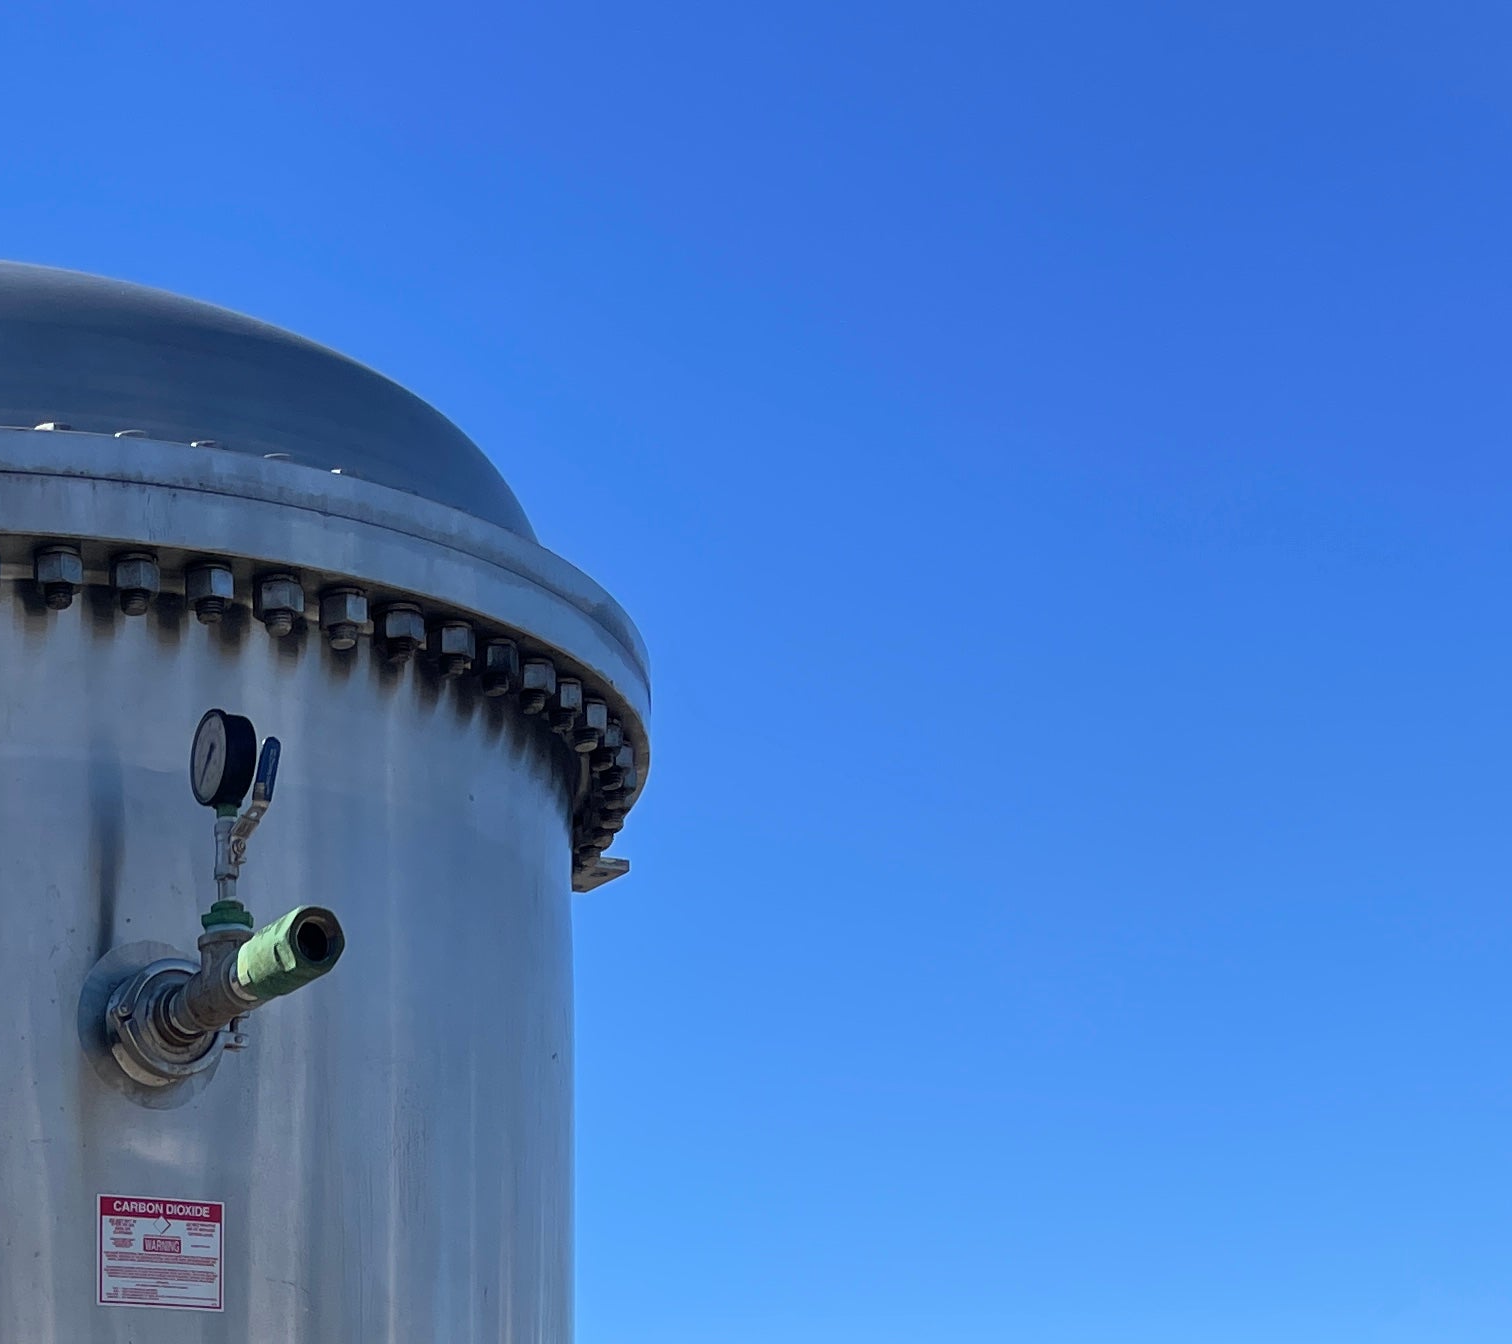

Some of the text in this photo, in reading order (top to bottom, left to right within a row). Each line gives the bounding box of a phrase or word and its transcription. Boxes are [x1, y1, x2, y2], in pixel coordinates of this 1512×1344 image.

[113, 1200, 210, 1217] CARBON DIOXIDE
[145, 1239, 180, 1253] WARNING
